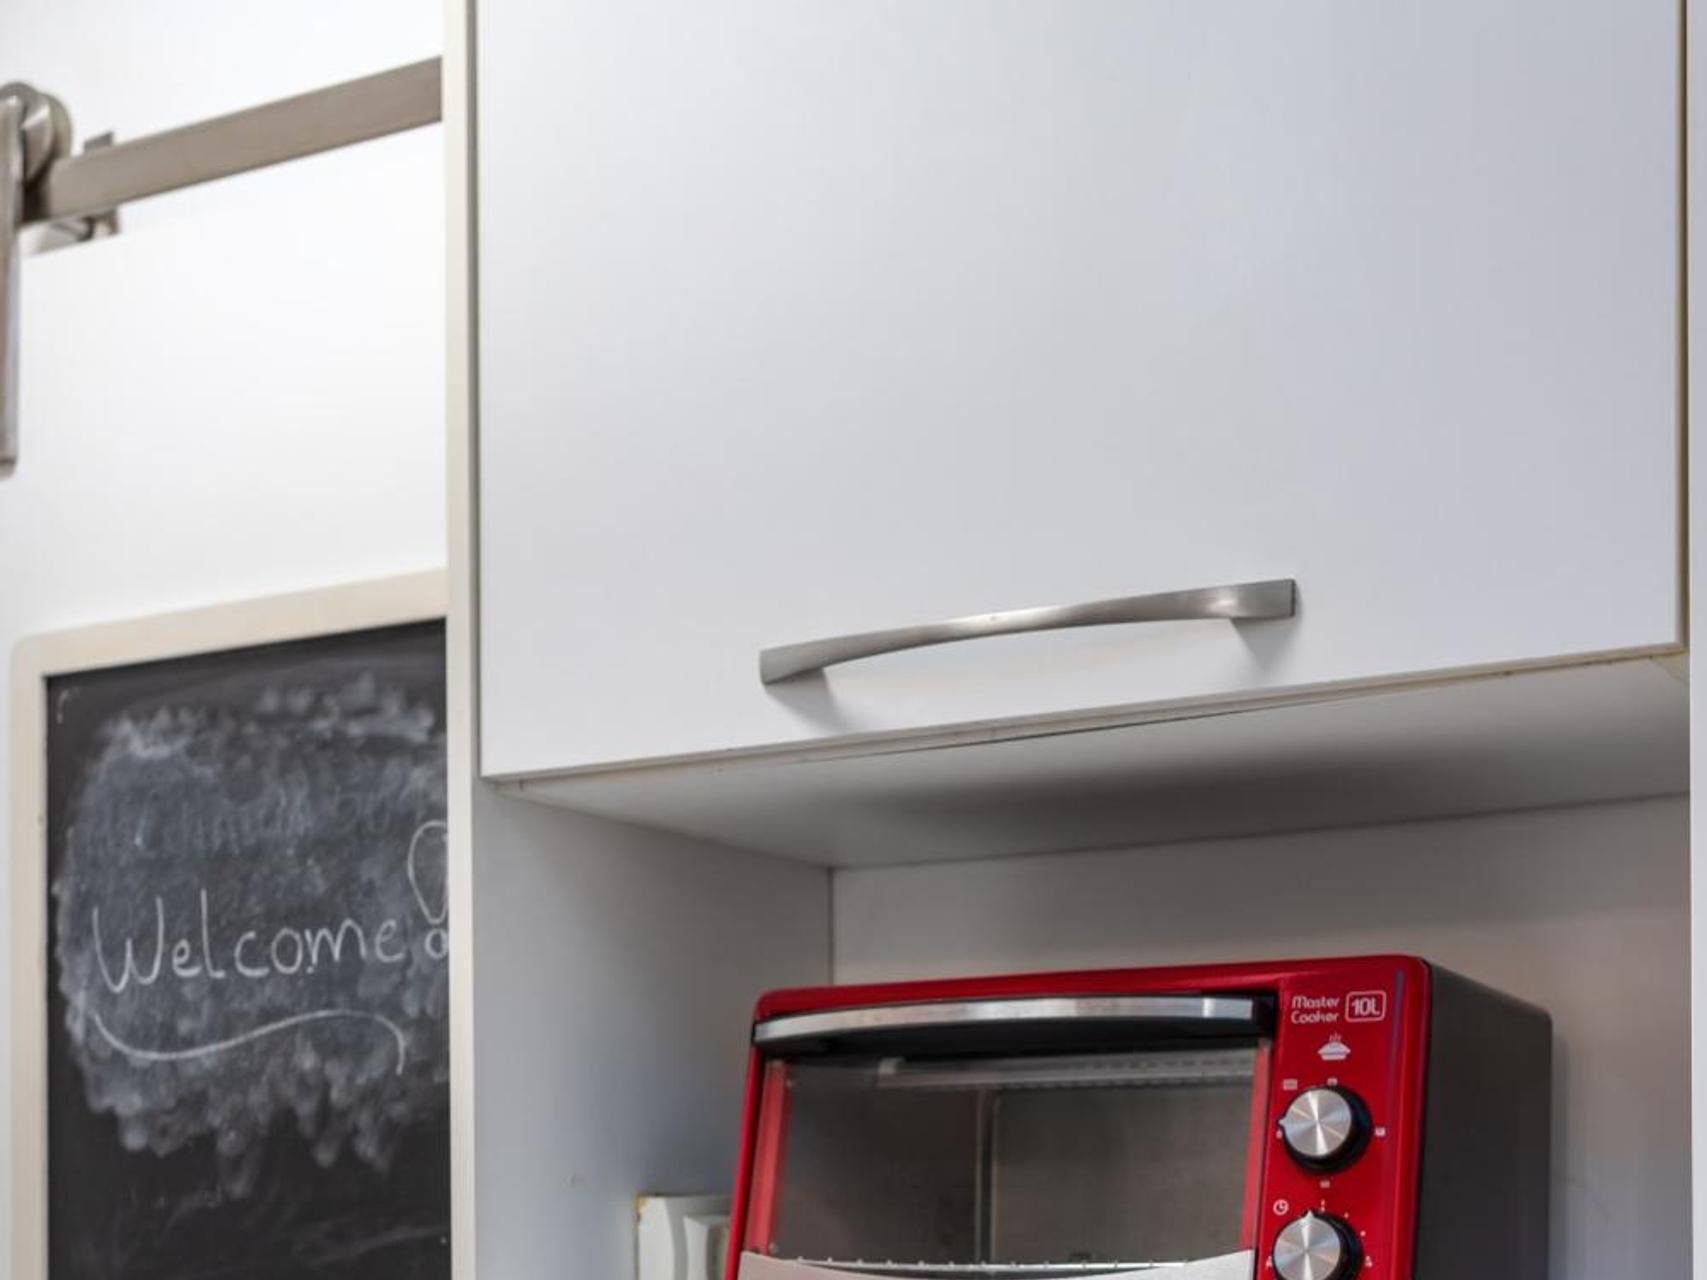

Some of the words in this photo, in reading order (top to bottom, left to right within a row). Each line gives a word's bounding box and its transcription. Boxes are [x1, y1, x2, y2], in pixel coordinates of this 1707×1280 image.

[1291, 995, 1340, 1009] Master
[1351, 996, 1381, 1017] 10L
[1290, 1010, 1339, 1024] Cooker
